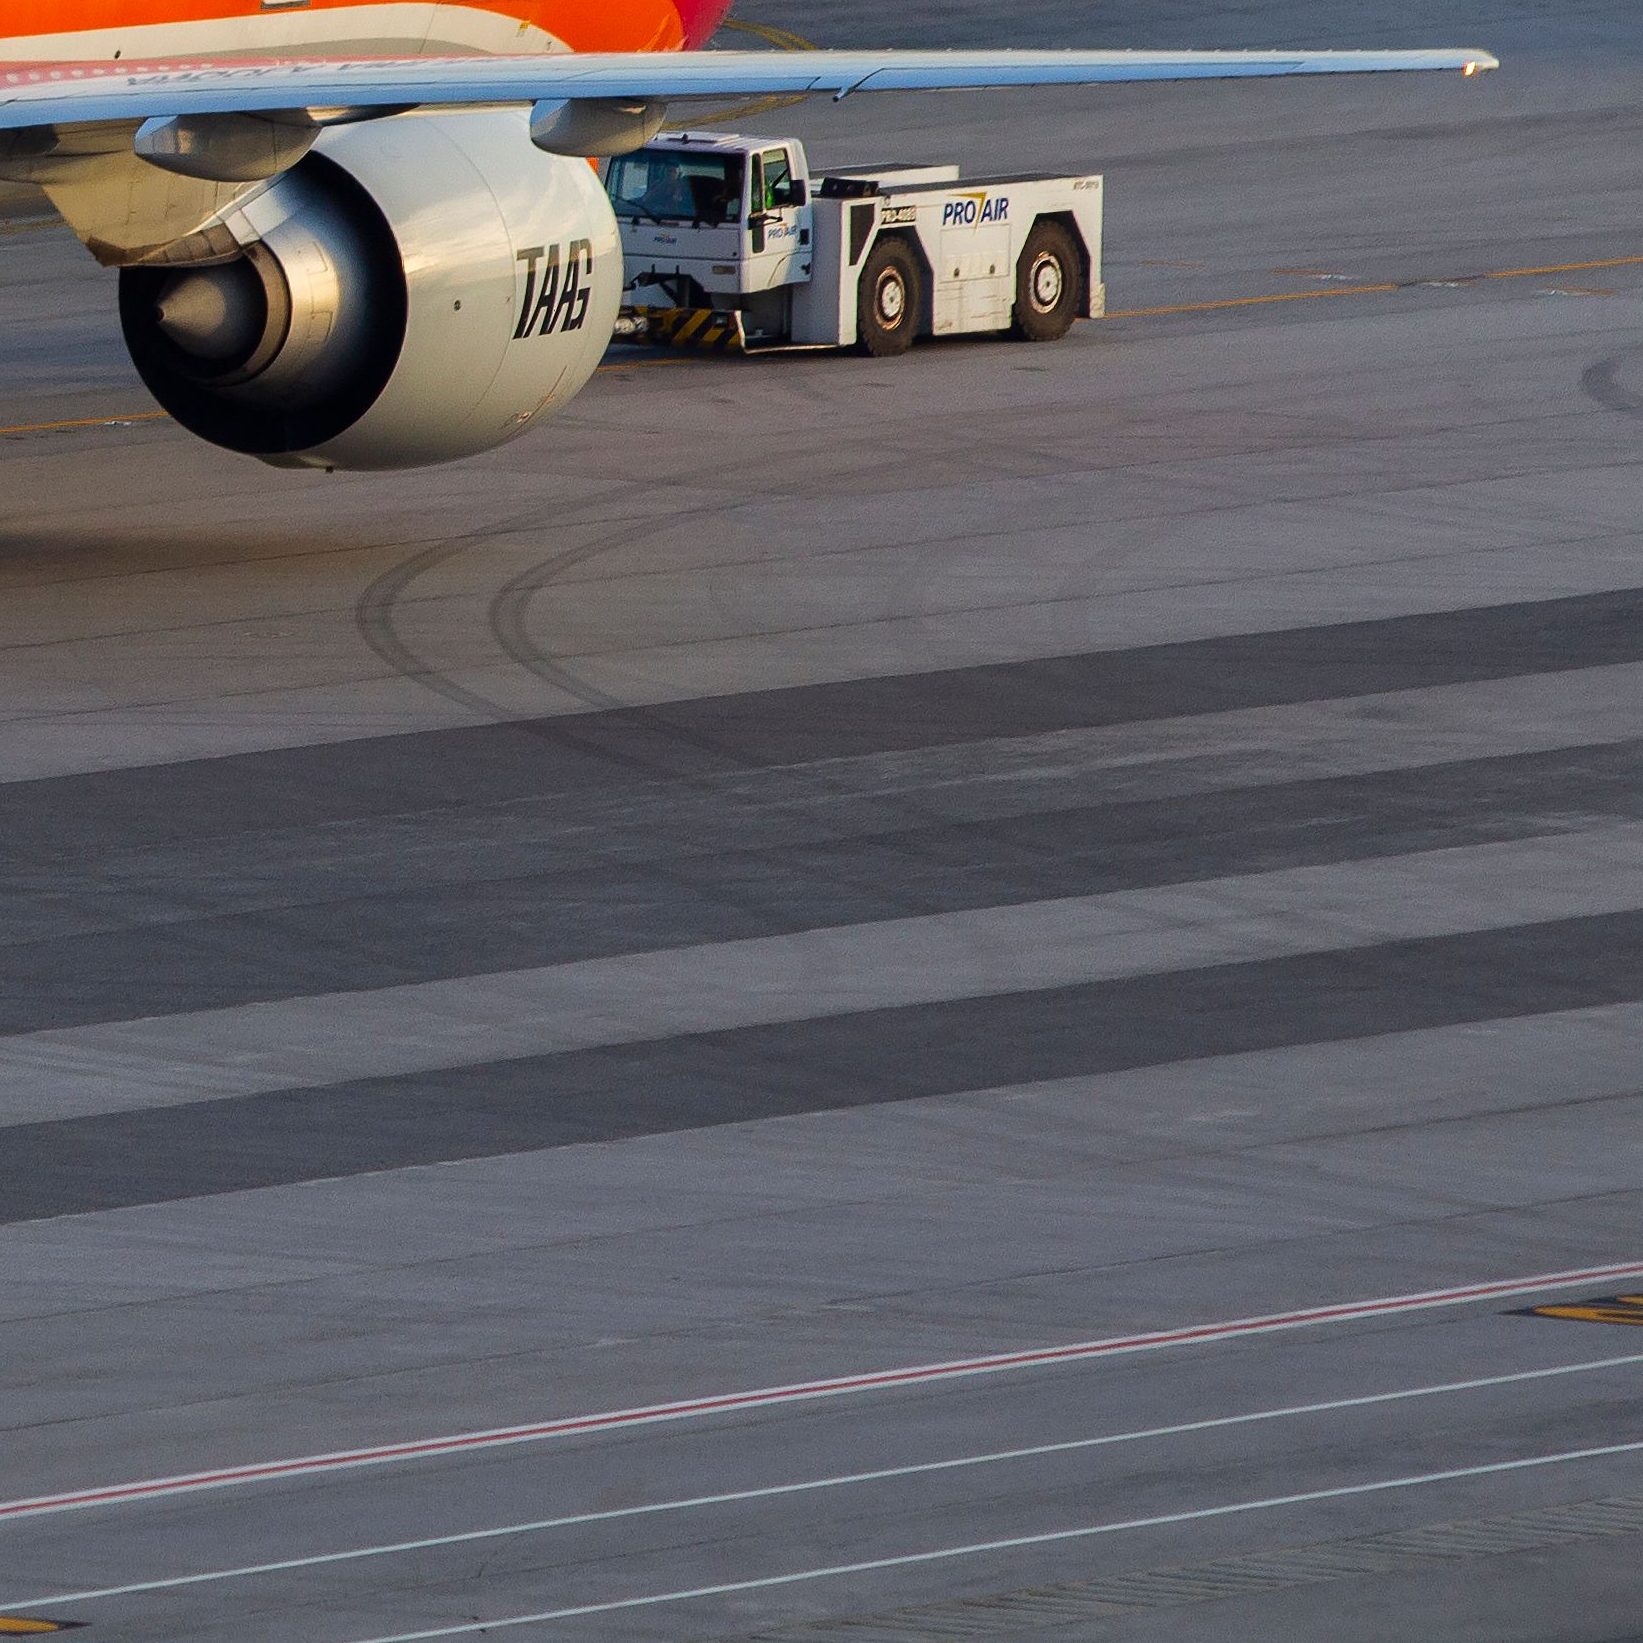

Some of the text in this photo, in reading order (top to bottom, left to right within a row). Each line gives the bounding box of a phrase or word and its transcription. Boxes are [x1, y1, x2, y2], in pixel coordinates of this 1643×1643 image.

[942, 198, 1009, 226] PRO AIR
[512, 238, 593, 340] TAAG
